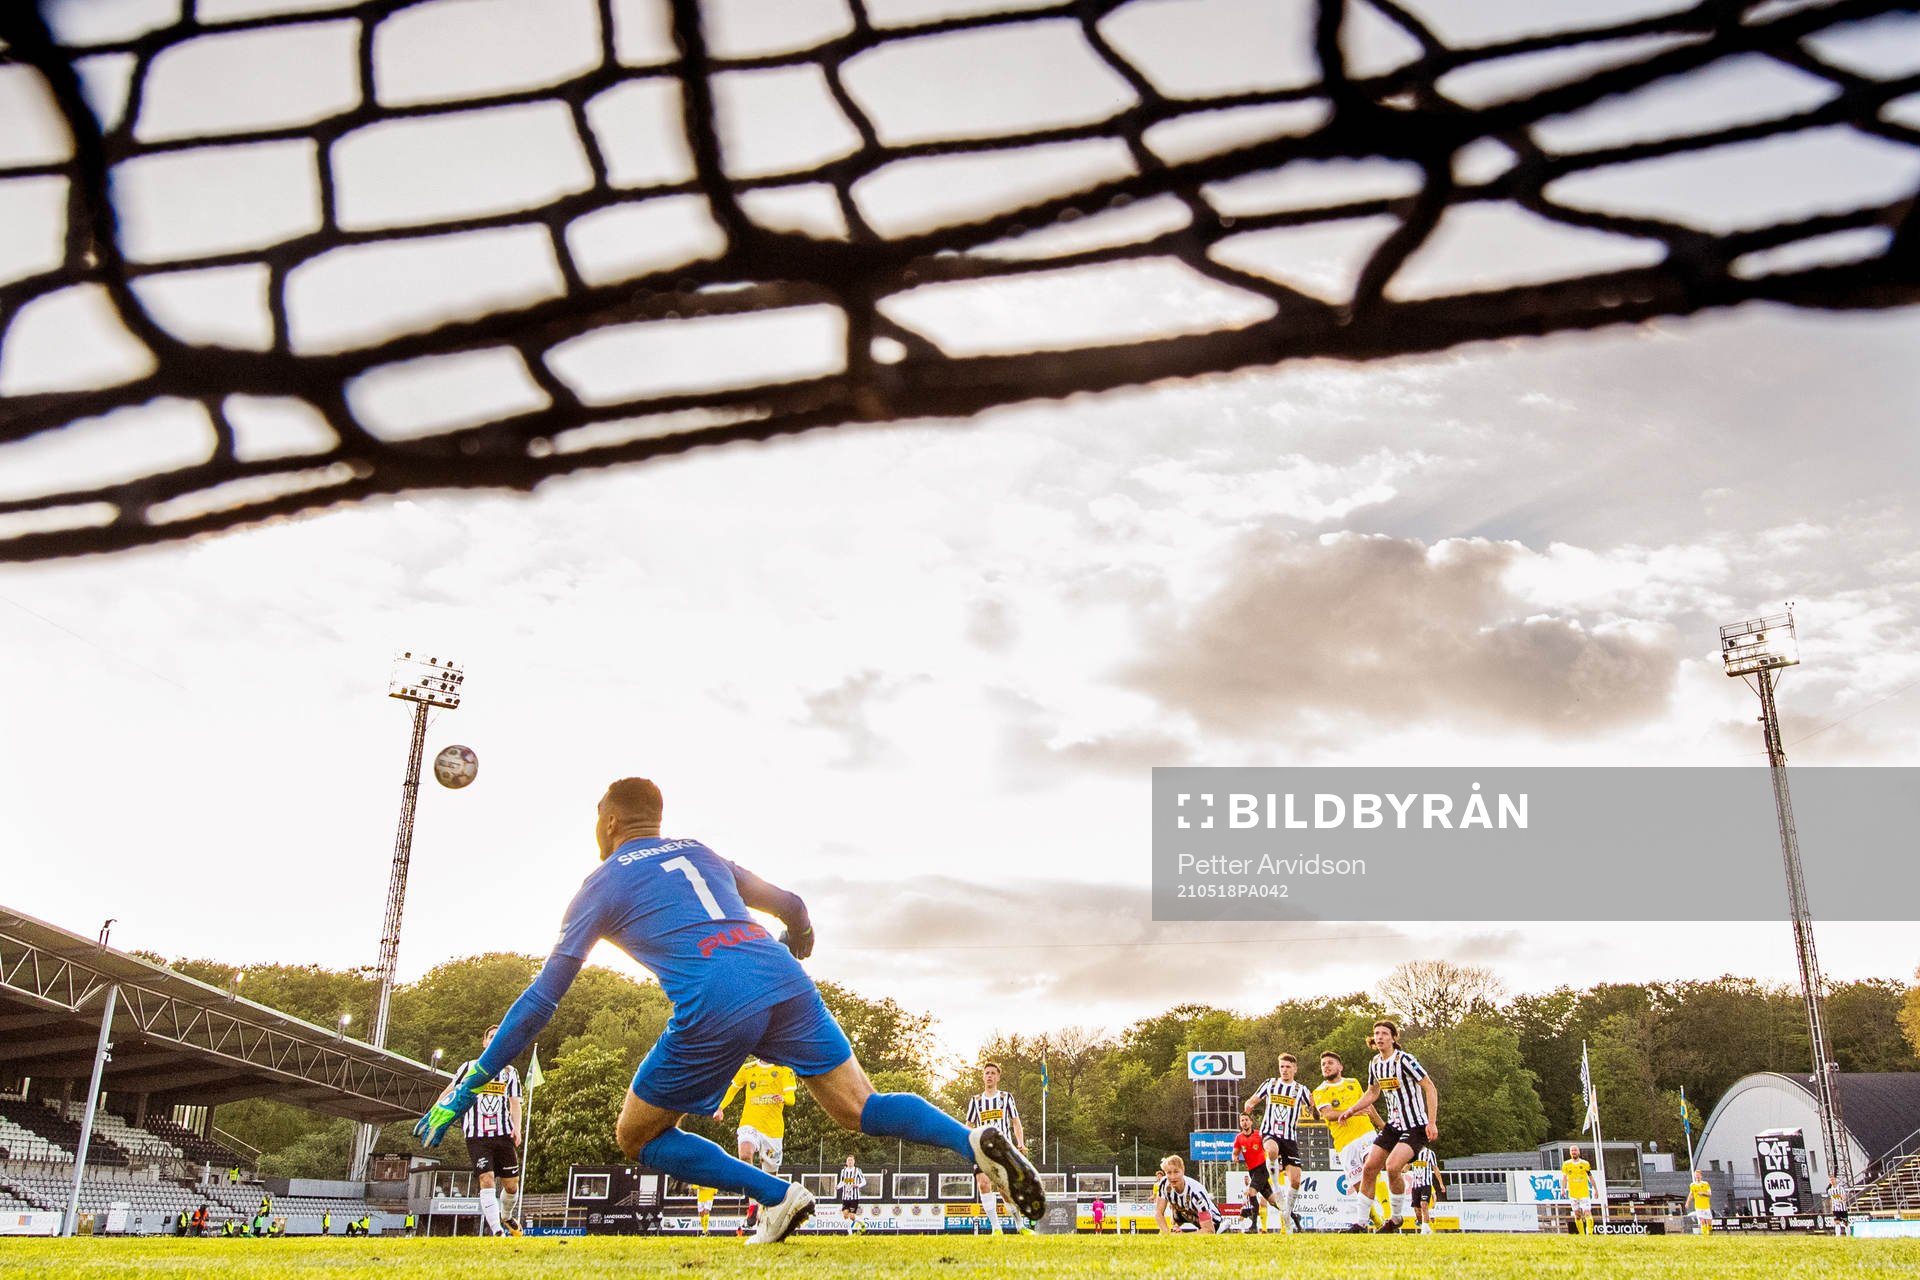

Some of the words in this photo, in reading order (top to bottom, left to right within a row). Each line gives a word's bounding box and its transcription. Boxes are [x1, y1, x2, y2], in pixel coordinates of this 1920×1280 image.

[617, 838, 699, 866] SERNEKE
[660, 855, 726, 920] 1
[1191, 1055, 1243, 1075] GDL
[1593, 1223, 1647, 1234] rocurator
